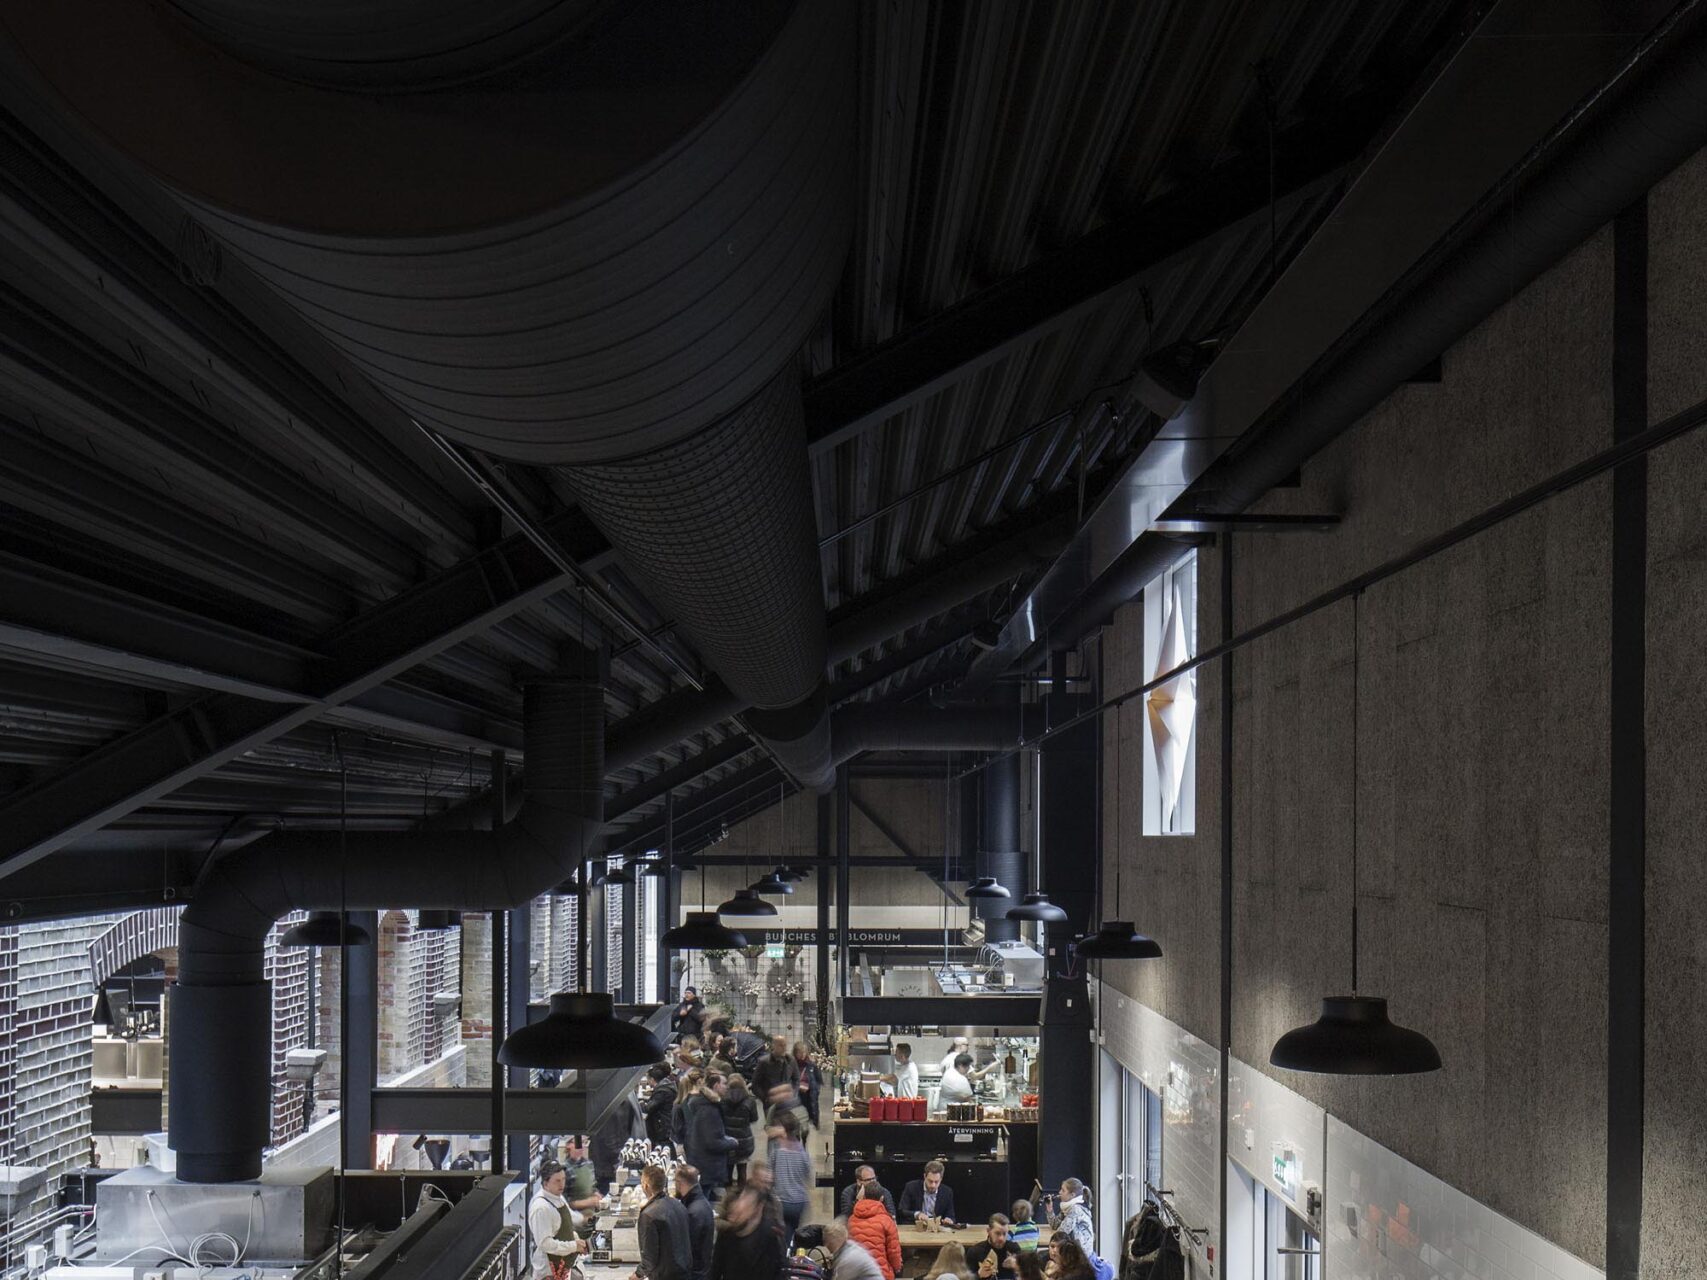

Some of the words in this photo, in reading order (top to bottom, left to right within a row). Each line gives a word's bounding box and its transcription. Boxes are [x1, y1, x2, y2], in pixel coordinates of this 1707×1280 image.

[765, 933, 816, 941] BUNCHES
[829, 933, 837, 941] B
[948, 1126, 994, 1134] ÅTERVINNING
